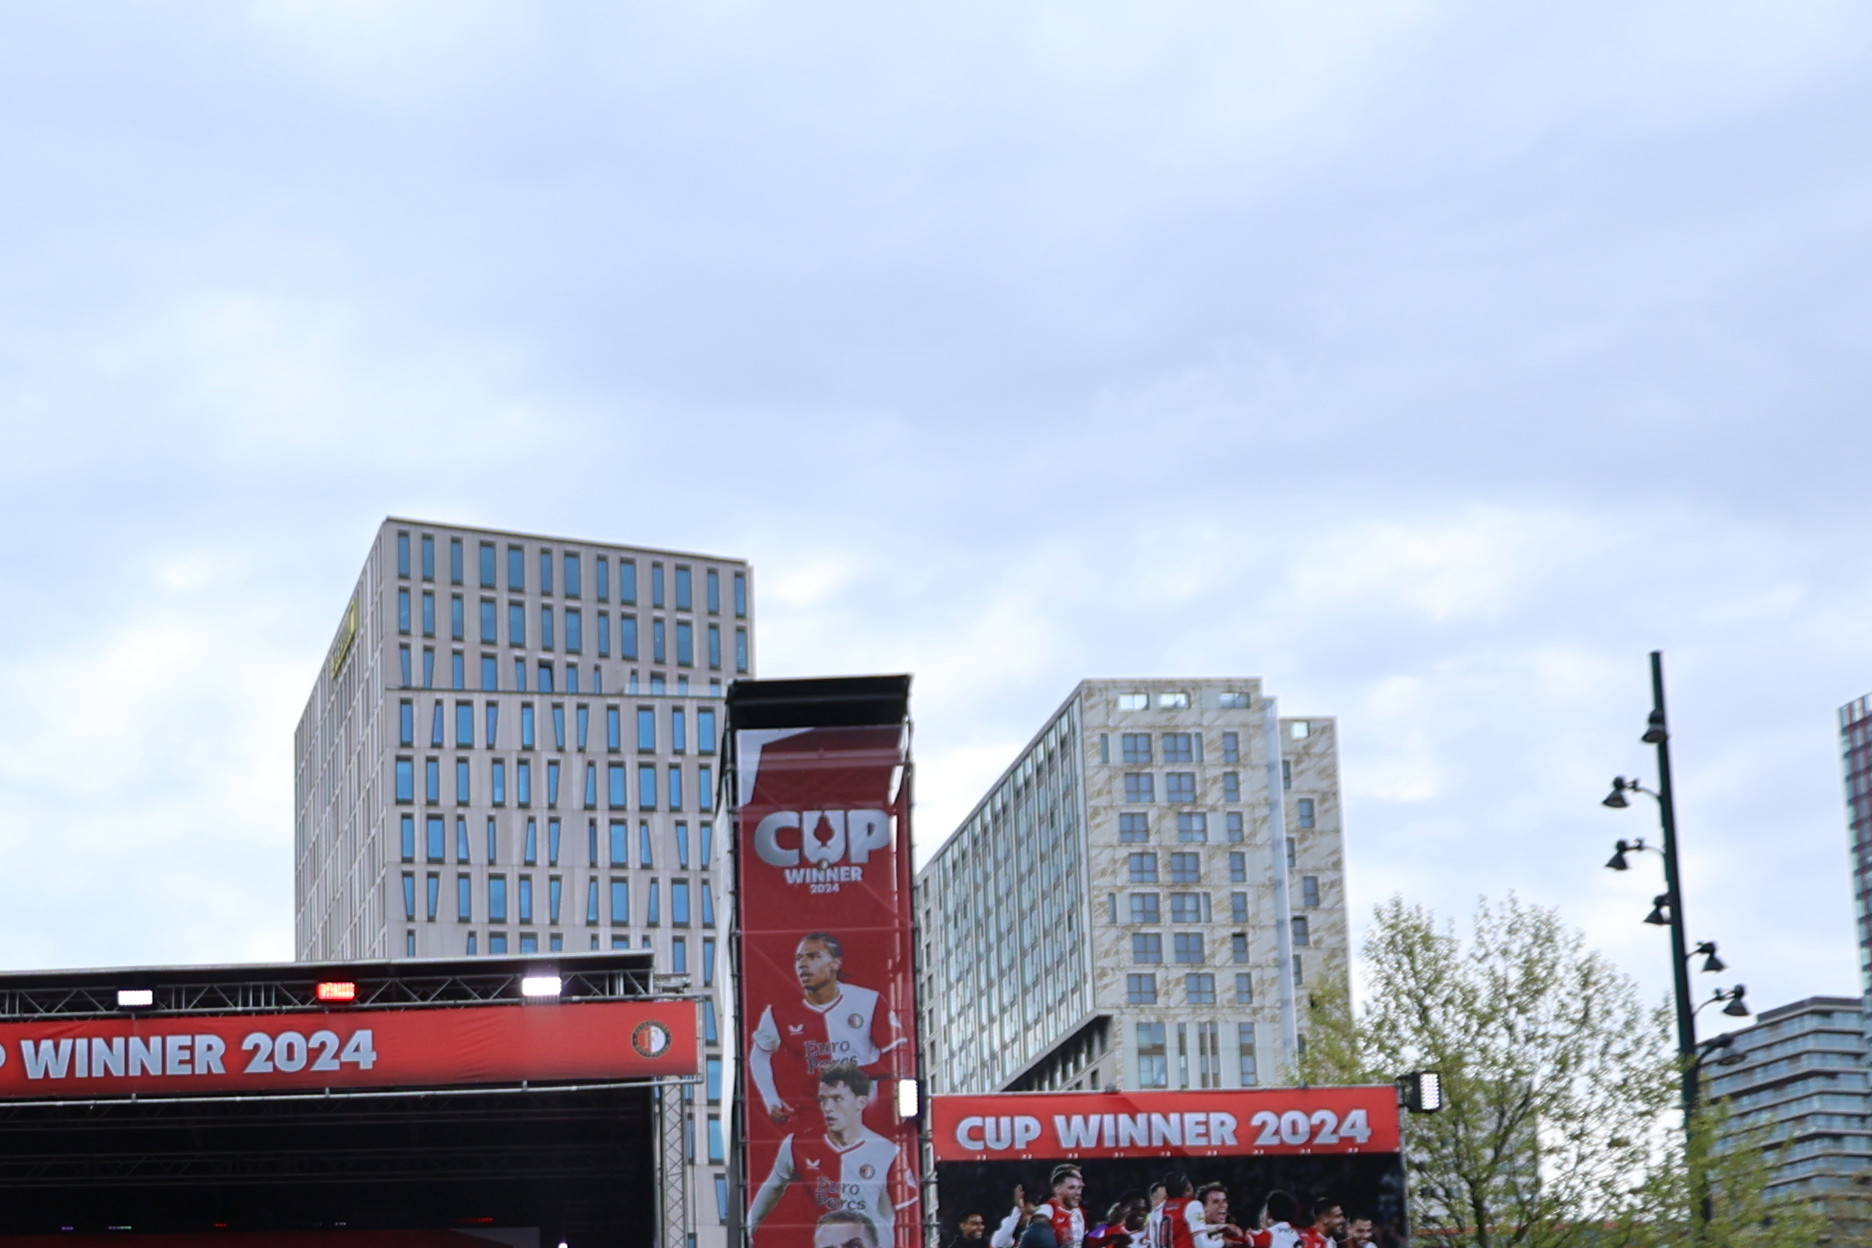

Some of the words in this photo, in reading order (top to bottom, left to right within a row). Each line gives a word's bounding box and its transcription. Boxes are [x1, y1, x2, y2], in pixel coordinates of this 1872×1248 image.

[754, 809, 892, 867] CUP
[785, 867, 863, 884] WINNER
[810, 884, 840, 894] 2024
[21, 1034, 226, 1080] WINNER
[242, 1029, 377, 1073] 2024
[956, 1116, 1042, 1150] CUP
[1054, 1112, 1239, 1148] WINNER
[1250, 1109, 1372, 1146] 2024
